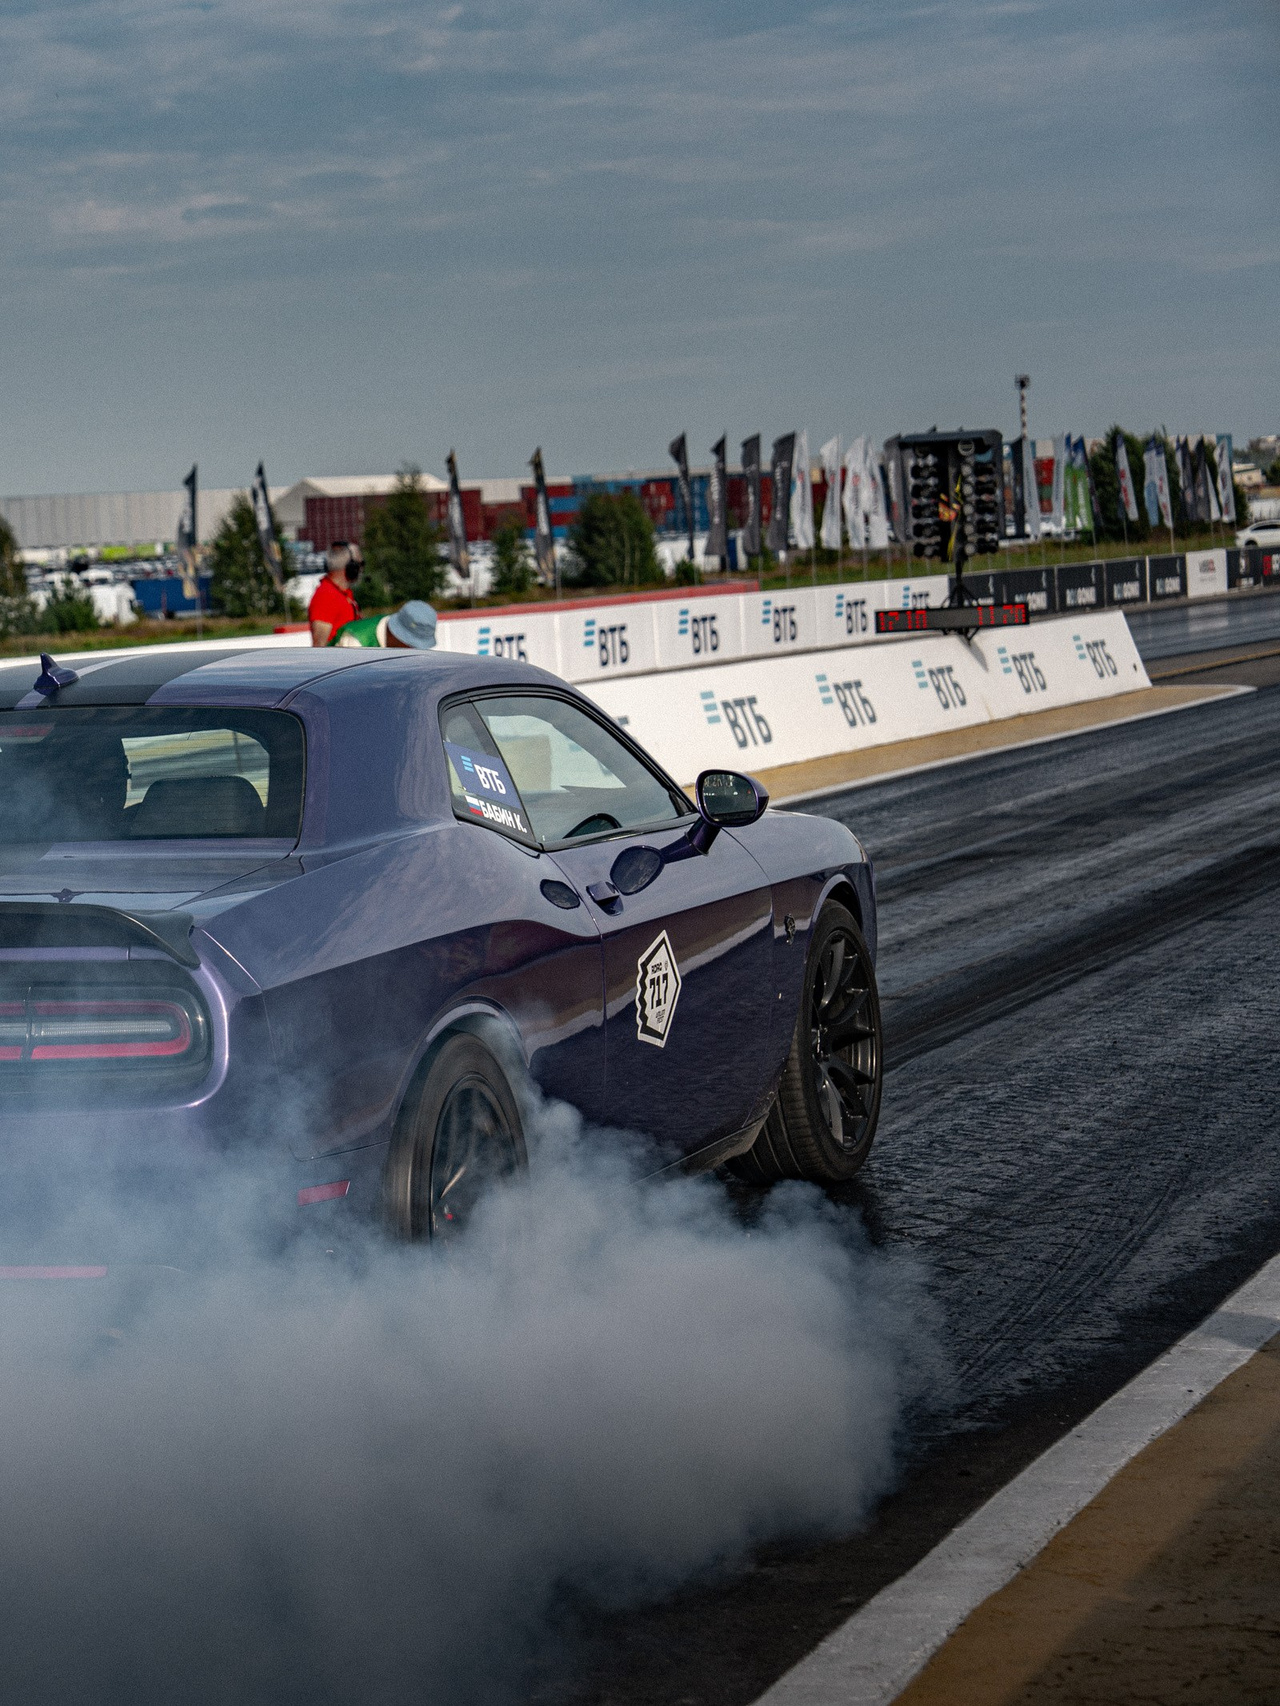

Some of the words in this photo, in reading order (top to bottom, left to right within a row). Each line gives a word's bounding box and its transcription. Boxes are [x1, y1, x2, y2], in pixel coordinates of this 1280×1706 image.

[692, 614, 719, 654] ВТБ
[774, 605, 797, 642] ВТБ
[846, 599, 867, 634] ВТБ
[598, 624, 629, 667] ВТБ
[1085, 639, 1118, 679] ВТБ
[928, 665, 967, 709] ВТБ
[1011, 652, 1048, 694] ВТБ
[721, 695, 773, 748] ВТБ
[833, 680, 877, 727] ВТБ
[474, 764, 506, 795] ВТБ
[479, 800, 516, 829] БАБИН
[650, 972, 668, 1010] 717
